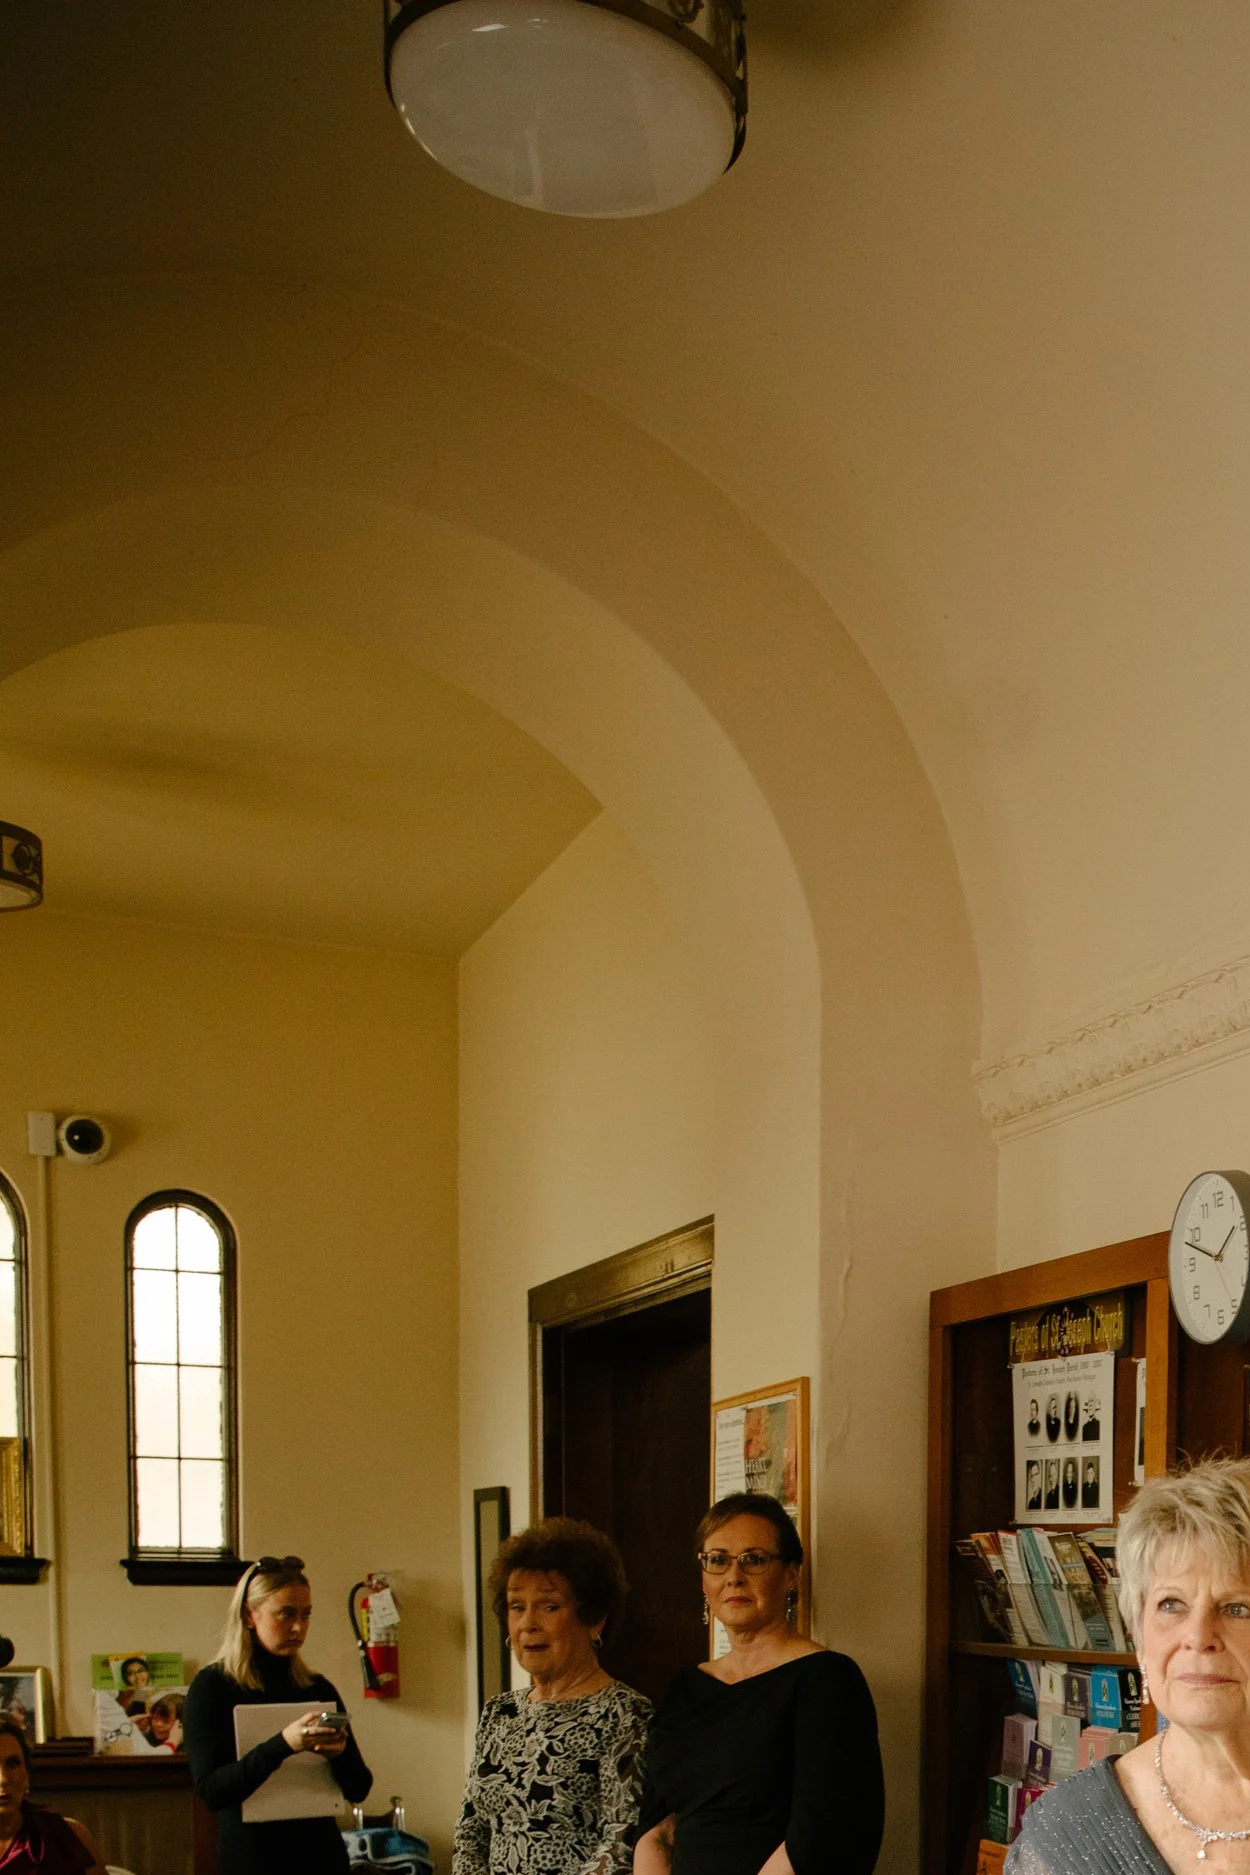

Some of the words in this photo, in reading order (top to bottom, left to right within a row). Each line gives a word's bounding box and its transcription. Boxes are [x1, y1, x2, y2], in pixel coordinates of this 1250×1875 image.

[1212, 1190, 1224, 1208] 12
[1201, 1203, 1209, 1219] 11
[1190, 1226, 1201, 1243] 10
[1188, 1256, 1196, 1272] 9
[1193, 1284, 1200, 1300] 8
[1203, 1303, 1211, 1320] 7
[1231, 1298, 1238, 1315] 5
[1217, 1308, 1225, 1326] 6
[1010, 1321, 1039, 1356] Pastors
[1062, 1307, 1091, 1354] Joseph
[1093, 1302, 1123, 1344] Church
